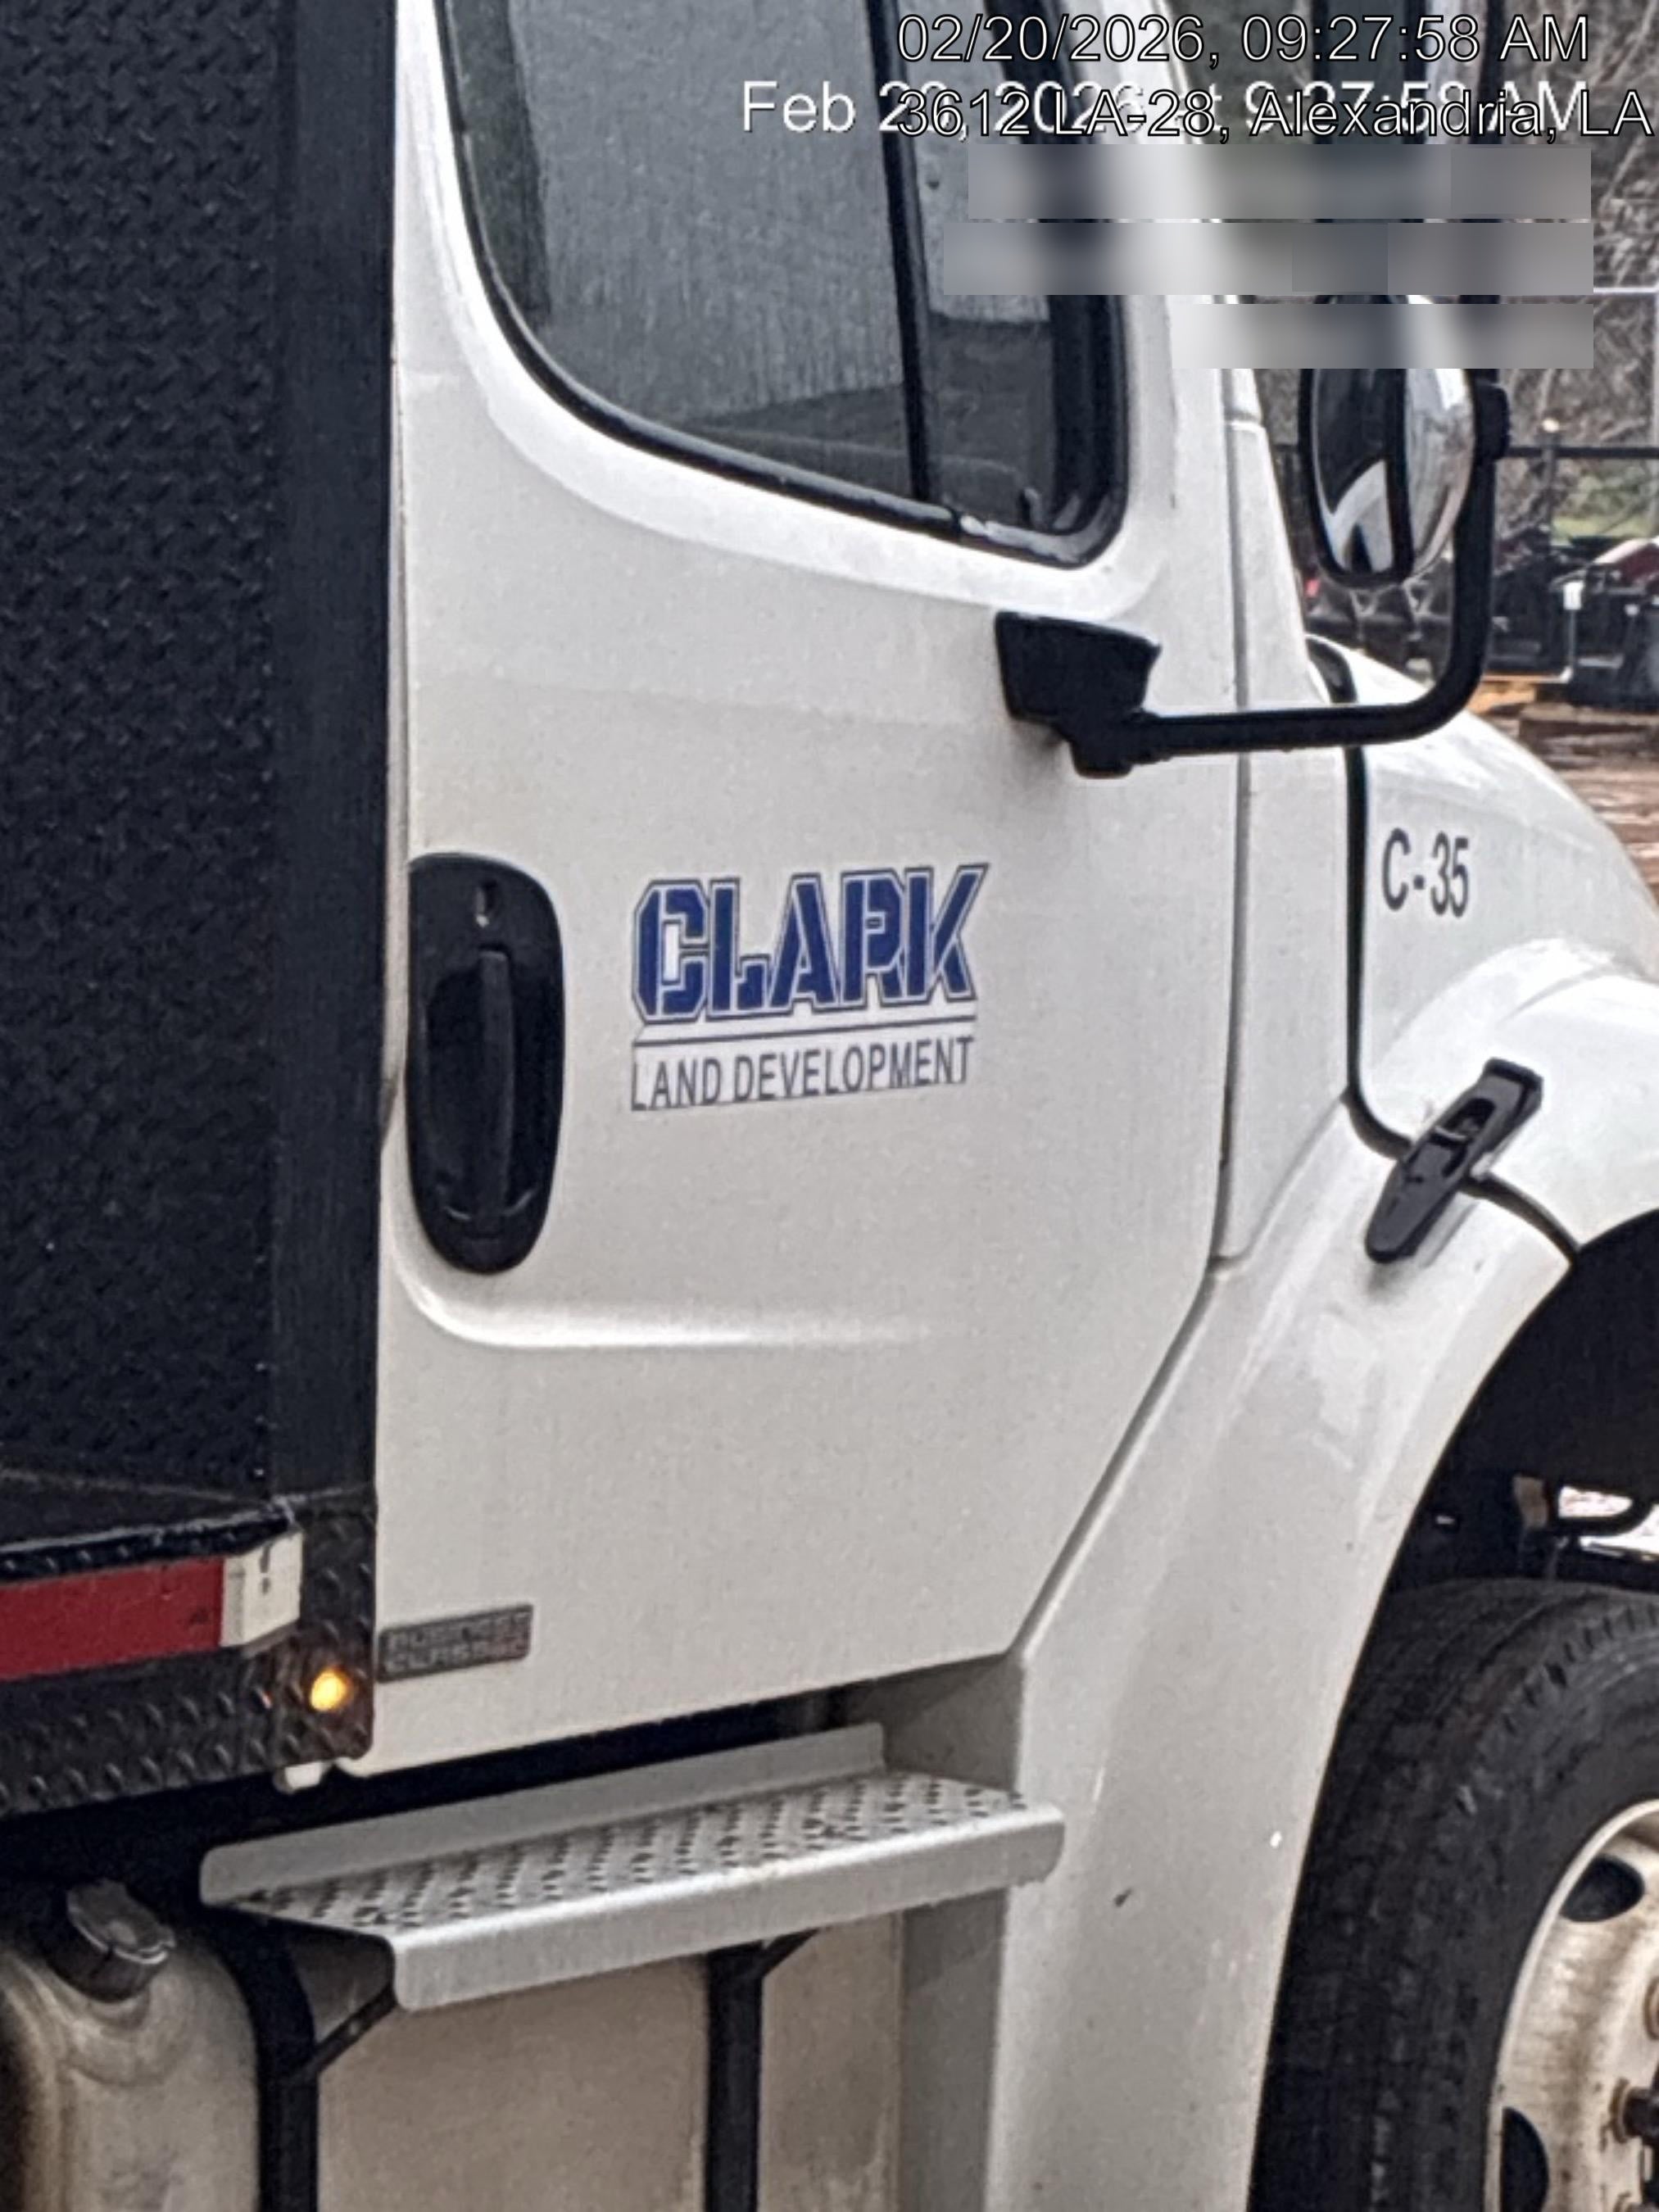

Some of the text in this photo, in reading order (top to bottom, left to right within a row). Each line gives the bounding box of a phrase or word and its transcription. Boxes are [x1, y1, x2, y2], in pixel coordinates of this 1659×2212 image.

[1380, 827, 1469, 919] C-35
[631, 863, 990, 1026] CLARK
[631, 1036, 974, 1112] LAND DEVELOPMENT
